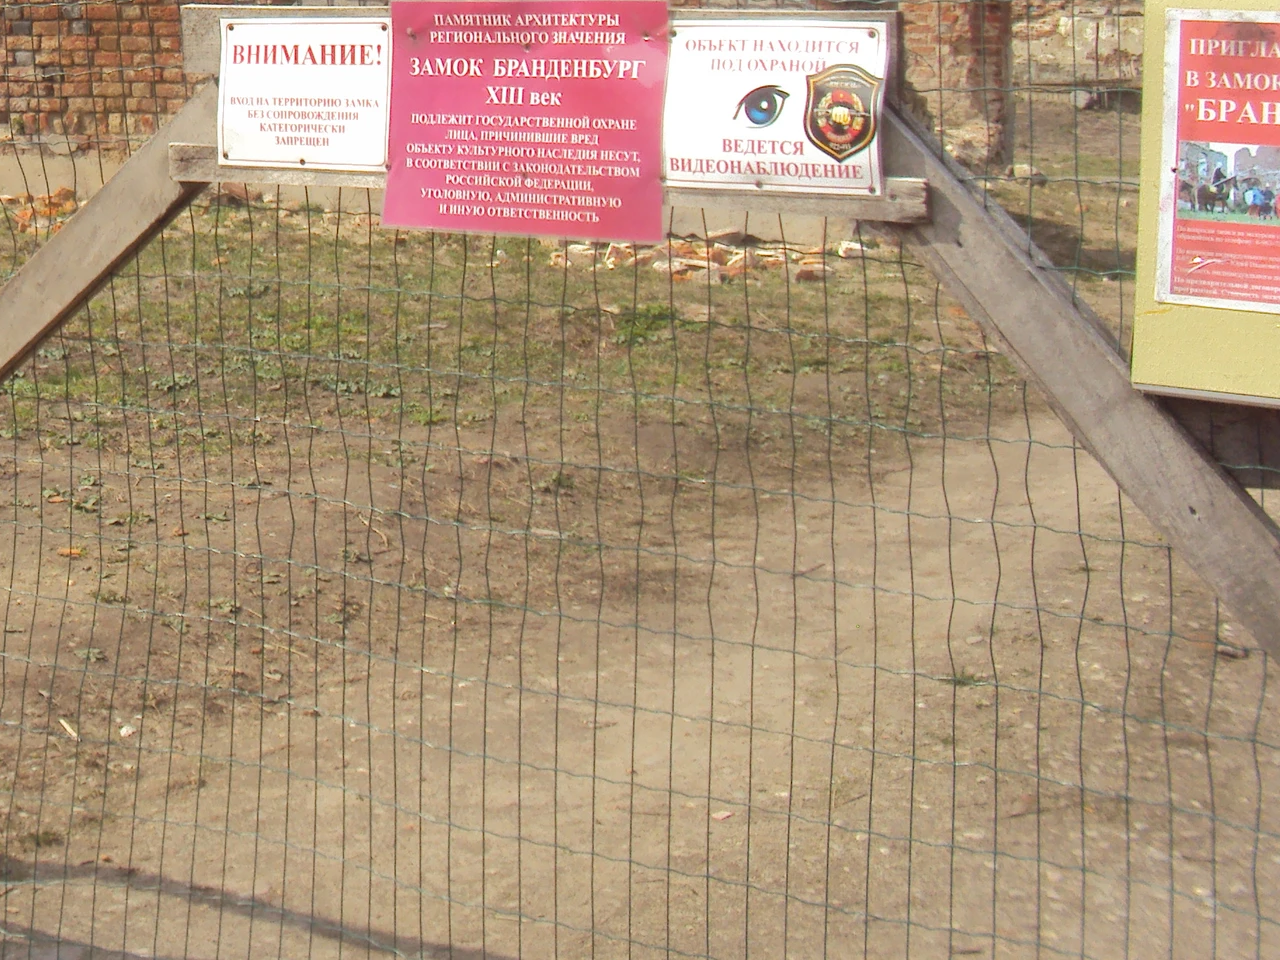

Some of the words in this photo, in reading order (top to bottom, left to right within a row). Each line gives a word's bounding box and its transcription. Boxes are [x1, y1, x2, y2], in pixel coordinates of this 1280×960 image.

[433, 13, 512, 27] ПАМЯТНИК
[514, 13, 620, 27] АРХИТЕКТУРЫ
[429, 31, 549, 45] РЕГИОНАЛЬНОГО
[552, 32, 626, 46] ЗНАЧЕНИЯ
[685, 39, 747, 52] ОБЪЕКТ
[753, 39, 859, 54] НАХОДИТСЯ
[232, 44, 382, 66] ВНИМАНИЕ!
[409, 57, 484, 77] ЗАМОК
[492, 59, 647, 81] БРАНДЕНБУРГ
[711, 58, 743, 72] ПОД
[747, 57, 827, 73] ОХРАНОЙ
[1185, 70, 1200, 87] В
[230, 97, 255, 107] ВХОД
[256, 97, 270, 107] НА
[272, 97, 342, 107] ТЕРРИТОРИЮ
[345, 98, 380, 108] ЗАМКА
[485, 86, 525, 105] XIII
[529, 91, 562, 106] век
[247, 109, 264, 119] БЕЗ
[266, 110, 359, 121] СОПРОВОЖДЕНИЯ
[410, 113, 474, 126] ПОДЛЕЖИТ
[475, 115, 590, 130] ГОСУДАРСТВЕННОЙ
[592, 118, 637, 131] ОХРАНЕ
[259, 122, 346, 134] КАТЕГОРИЧЕСКИ
[444, 129, 479, 142] ЛИЦА,
[480, 130, 569, 145] ПРИЧИНИВШИЕ
[571, 134, 599, 145] ВРЕД
[275, 136, 330, 147] ЗАПРЕЩЕН
[721, 138, 805, 156] ВЕДЕТСЯ
[406, 143, 454, 155] ОБЪЕКТУ
[457, 145, 535, 159] КУЛЬТУРНОГО
[537, 147, 597, 161] НАСЛЕДИЯ
[600, 150, 641, 163] НЕСУТ,
[406, 157, 413, 167] В
[415, 158, 500, 172] СООТВЕТСТВИИ
[502, 161, 510, 172] С
[512, 162, 640, 178] ЗАКОНОДАТЕЛЬСТВОМ
[669, 158, 864, 180] ВИДЕОНАБЛЮДЕНИЕ
[445, 173, 521, 188] РОССИЙСКОЙ
[523, 177, 595, 192] ФЕДЕРАЦИИ,
[420, 188, 493, 202] УГОЛОВНУЮ,
[495, 192, 622, 208] АДМИНИСТРАТИВНУЮ
[439, 203, 447, 214] И
[449, 204, 485, 217] ИНУЮ
[487, 206, 600, 223] ОТВЕТСТВЕННОСТЬ
